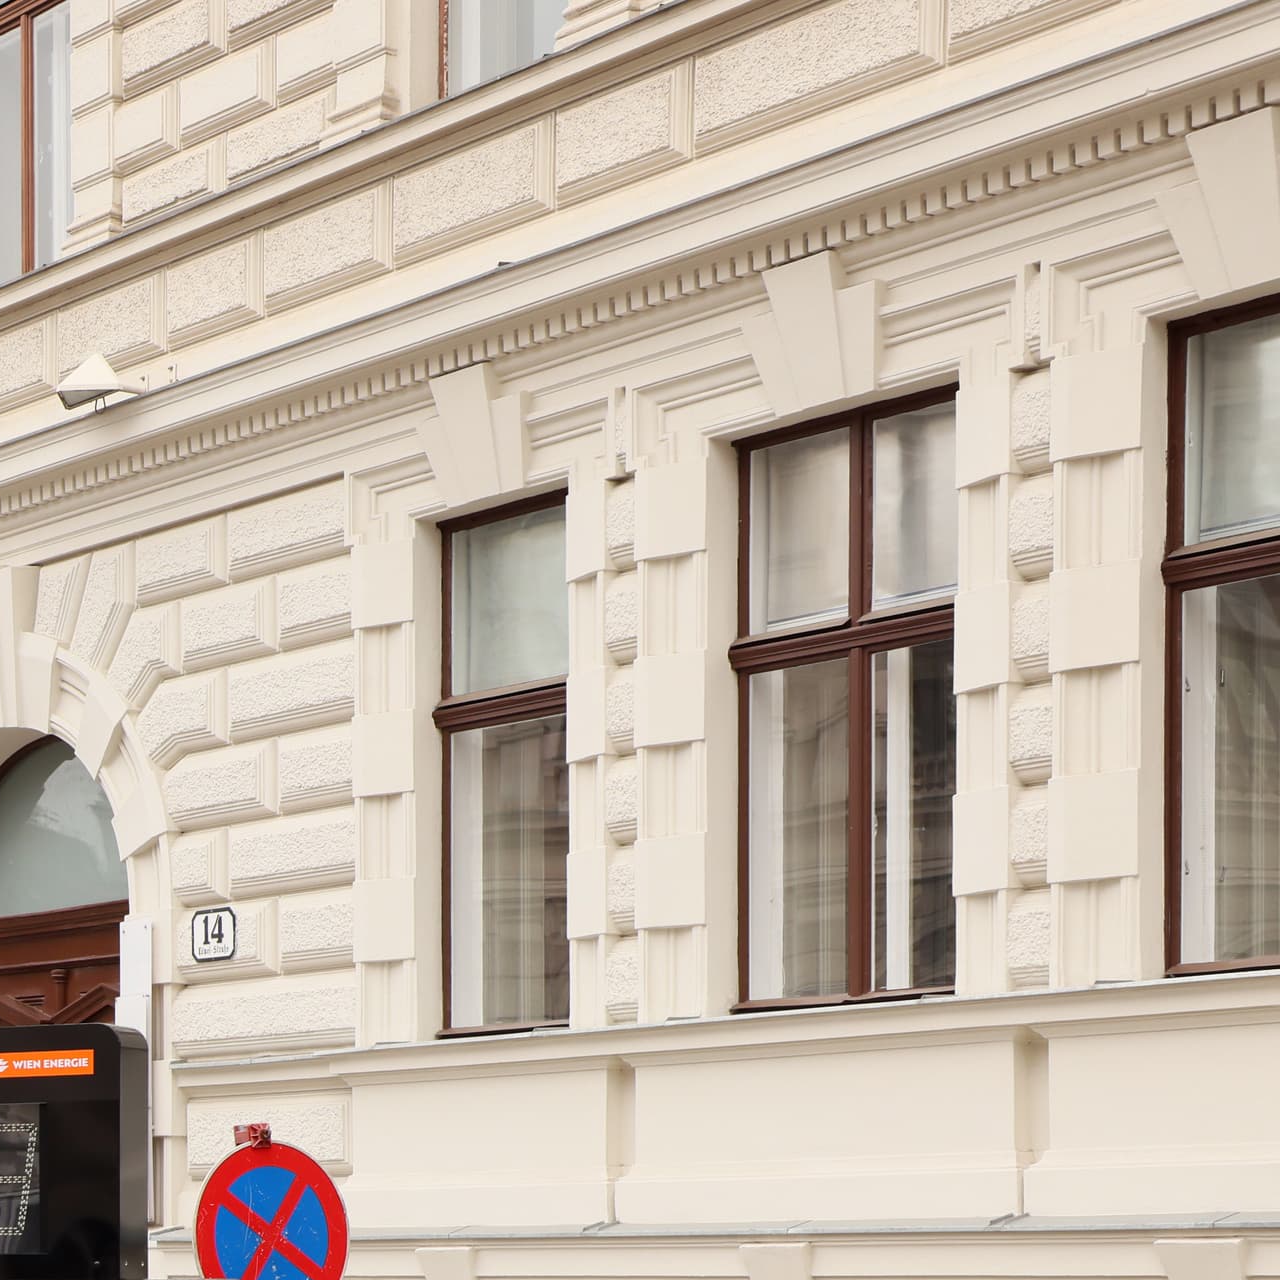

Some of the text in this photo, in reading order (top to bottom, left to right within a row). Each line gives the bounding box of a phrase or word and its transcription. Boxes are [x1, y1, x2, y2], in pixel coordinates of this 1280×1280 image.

[202, 914, 225, 945] 14
[12, 1055, 90, 1072] WIEN ENERGIE
